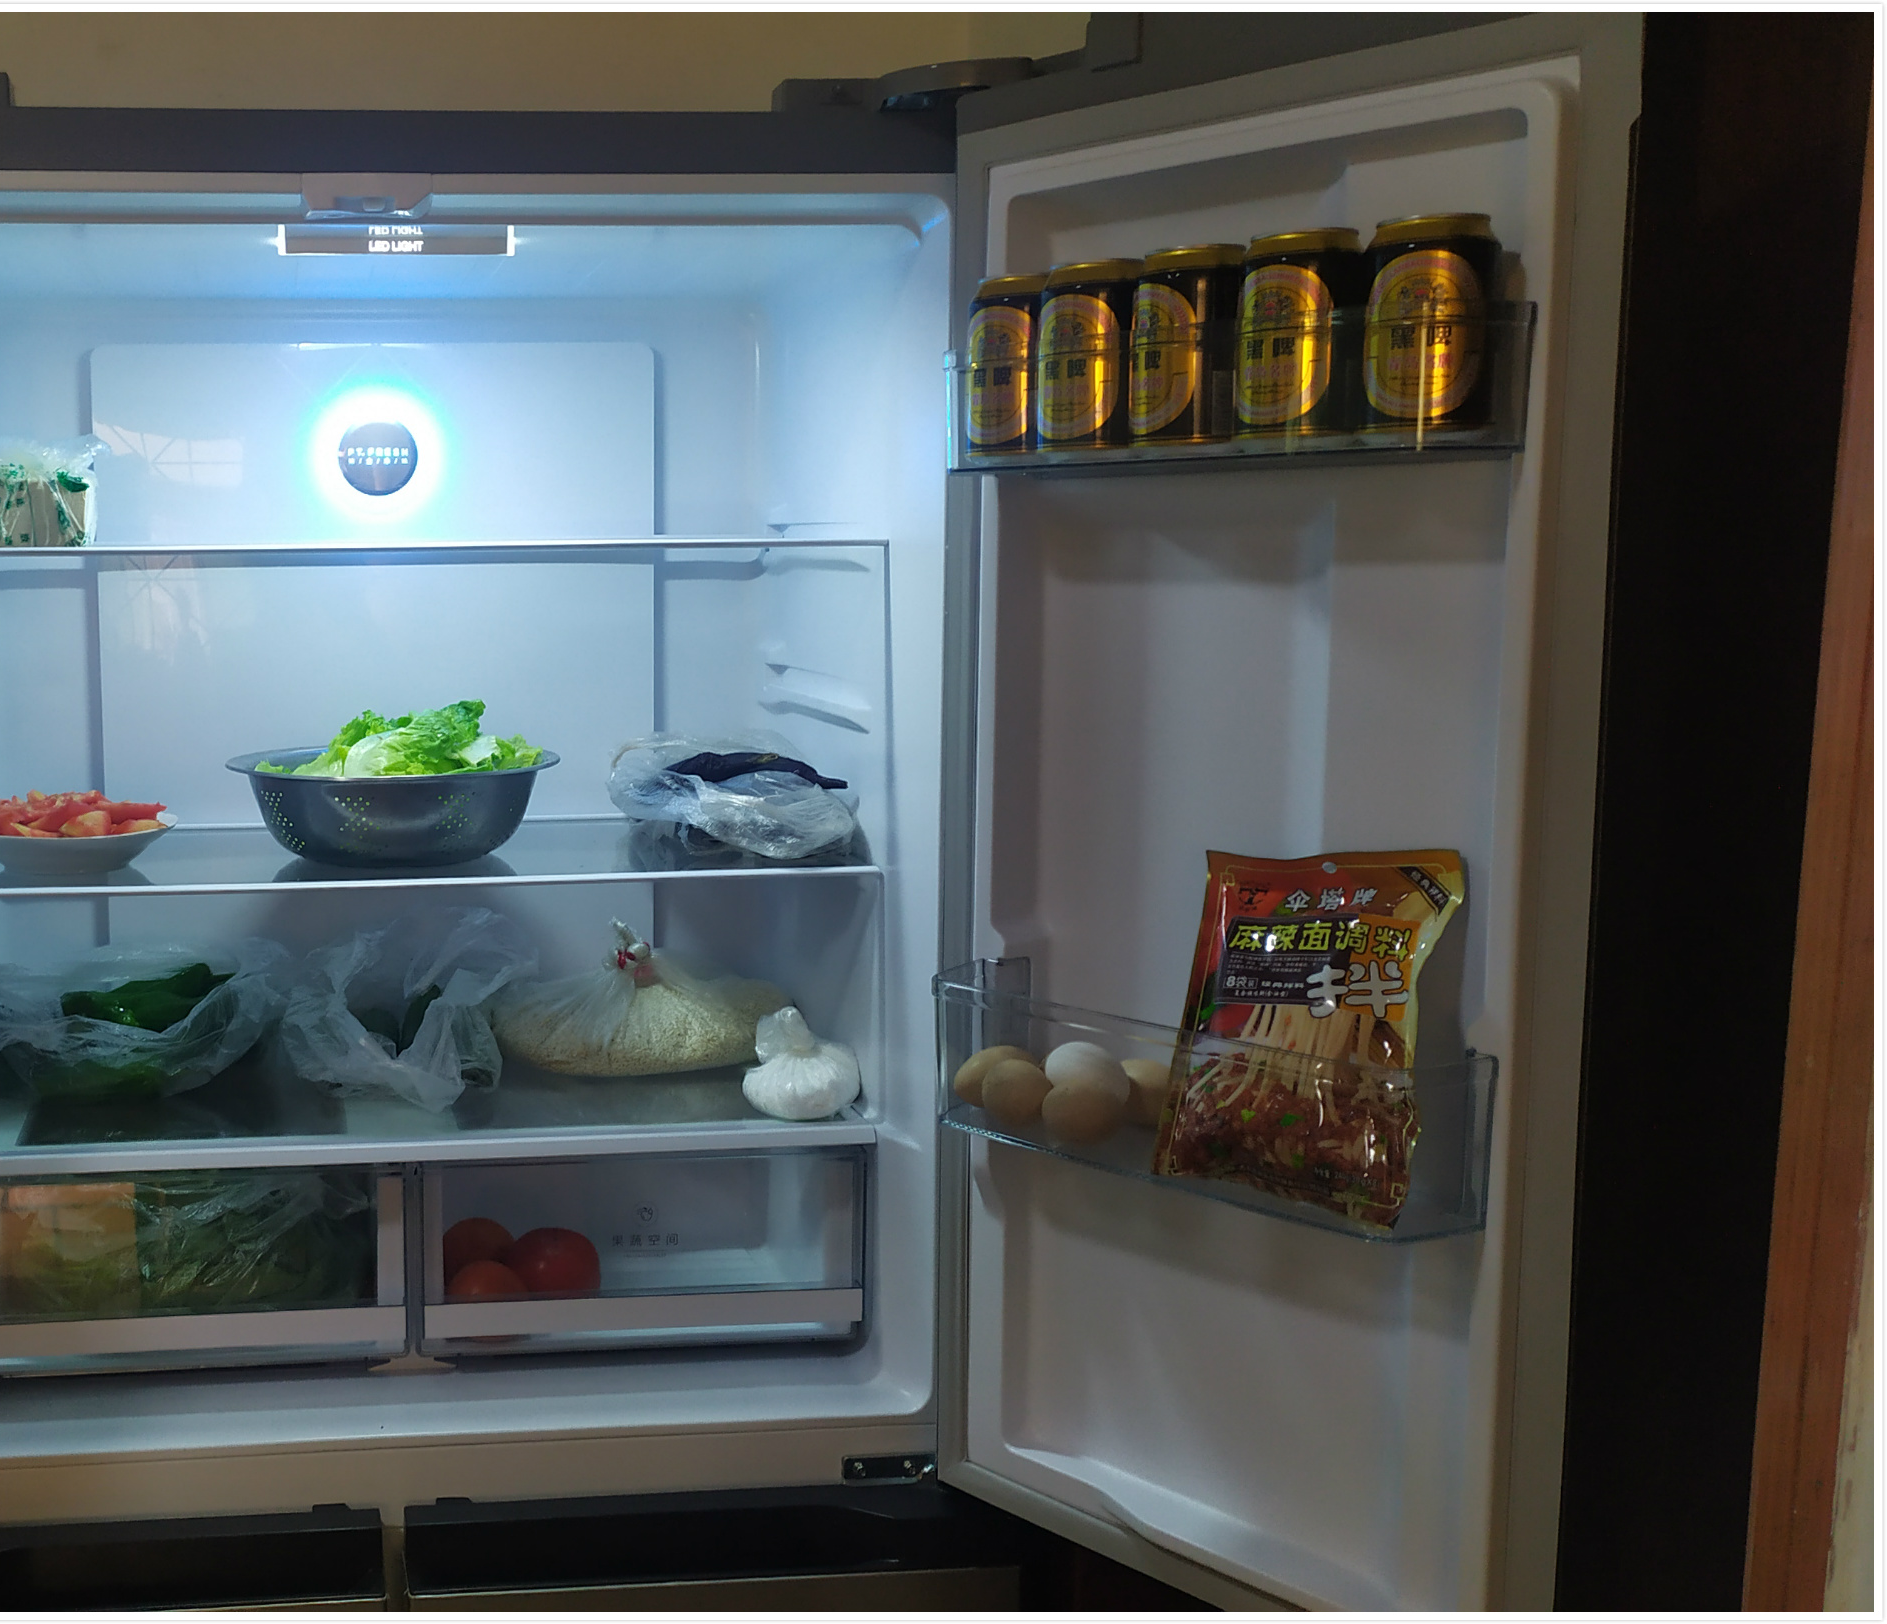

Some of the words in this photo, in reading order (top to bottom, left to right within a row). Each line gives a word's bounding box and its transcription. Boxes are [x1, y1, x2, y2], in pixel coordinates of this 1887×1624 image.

[368, 240, 390, 252] LED
[391, 240, 424, 252] LIGHT
[1246, 336, 1296, 360] 黑啤
[1045, 358, 1087, 381] 黑啤
[1284, 886, 1379, 913] 伞塔牌
[1228, 919, 1412, 962] 麻辣面调料
[1306, 960, 1410, 1019] 拌
[612, 1233, 679, 1247] 果蔬空间
